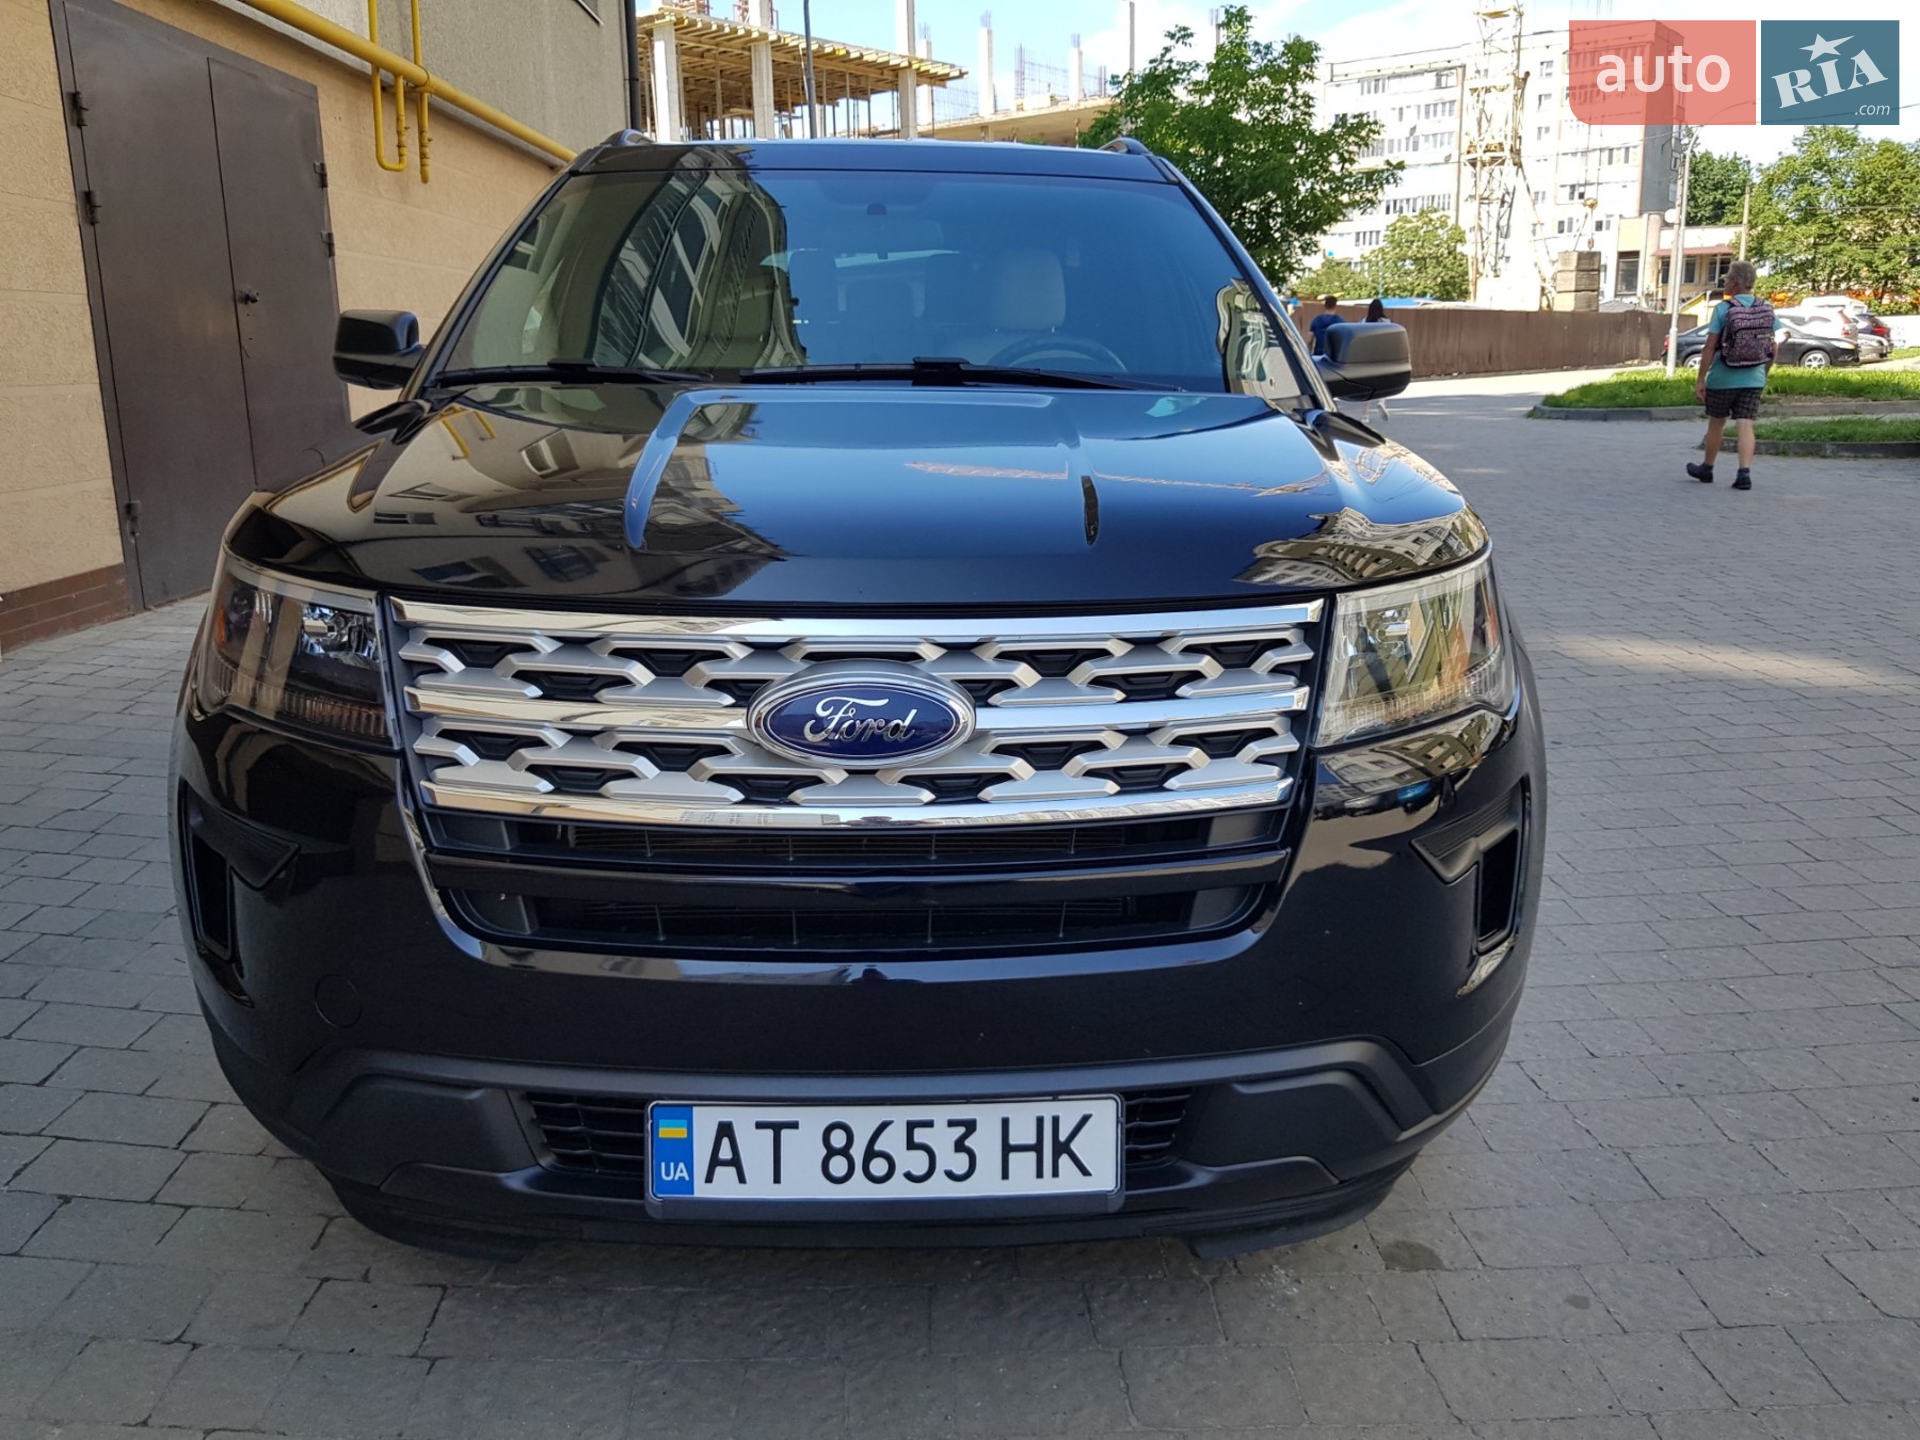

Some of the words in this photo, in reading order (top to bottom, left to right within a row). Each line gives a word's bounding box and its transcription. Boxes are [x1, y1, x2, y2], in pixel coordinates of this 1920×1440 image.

[803, 696, 919, 743] Ford
[660, 1162, 690, 1181] UA
[703, 1119, 800, 1185] AT
[820, 1117, 978, 1185] 8653
[1000, 1113, 1093, 1181] HK
